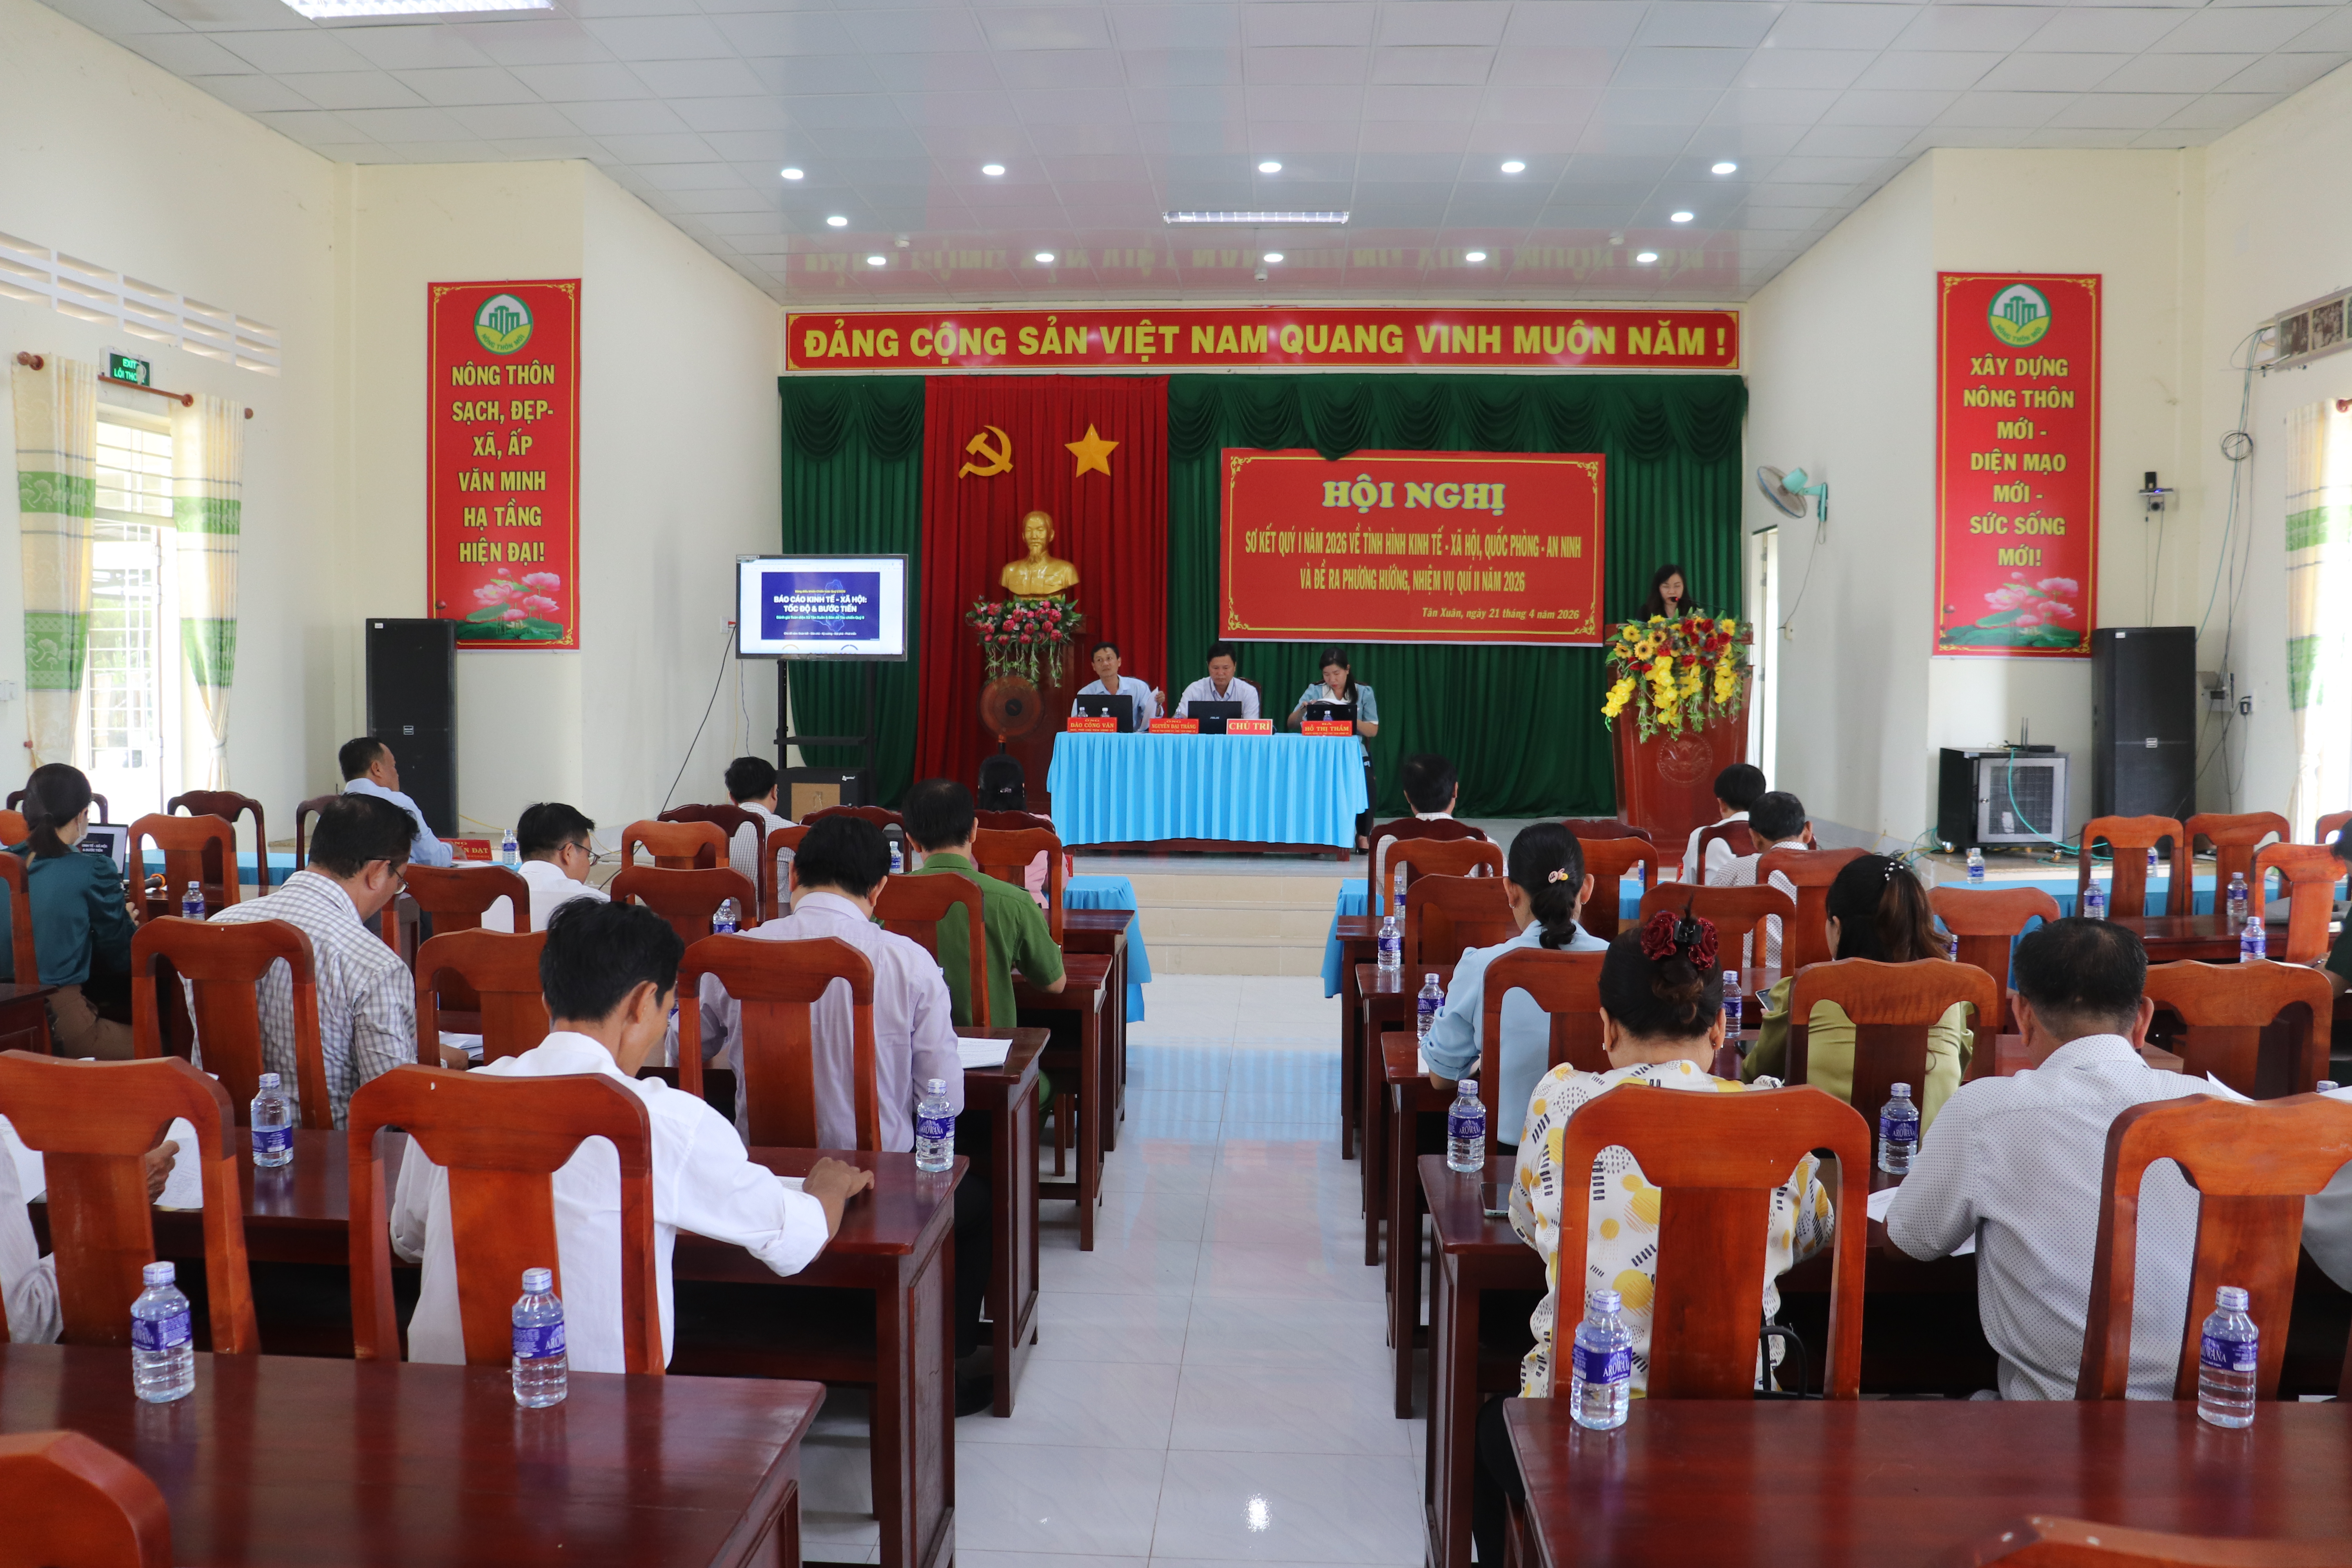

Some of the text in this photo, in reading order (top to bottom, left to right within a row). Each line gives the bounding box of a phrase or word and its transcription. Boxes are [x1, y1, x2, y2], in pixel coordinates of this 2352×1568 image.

[482, 334, 495, 348] NÔNG
[804, 316, 1726, 365] ĐẢNG CỘNG SẢN VIỆT NAM QUANG VINH MUÔN NĂM !
[122, 358, 137, 369] EXIT
[452, 359, 555, 387] NÔNG THÔN
[1970, 352, 2069, 381] XÂY DỰNG
[1963, 385, 2075, 409] NÔNG THÔN
[452, 400, 554, 425] SẠCH, ĐẸP-
[1997, 417, 2035, 440] MỚI
[472, 427, 534, 460] XÃ, ẤP
[1970, 448, 2067, 476] DIỆN MẠO
[458, 468, 546, 492] VĂN MINH
[1993, 480, 2031, 503] MỚI
[1323, 474, 1506, 516] HỘI NGHỊ
[463, 498, 542, 532] HẠ TẦNG
[1969, 510, 2067, 536] SỨC SỐNG
[459, 537, 545, 567] HIỆN ĐẠI!
[1245, 528, 1258, 553] SƠ
[1259, 523, 1276, 553] KẾT
[1278, 526, 1296, 557] QUÝ
[1298, 532, 1302, 553] I
[1304, 528, 1323, 554] NĂM
[1325, 532, 1347, 554] 2026
[1349, 523, 1361, 554] VỀ
[1363, 527, 1383, 554] TÌNH
[1385, 528, 1406, 555] HÌNH
[1408, 533, 1429, 555] KINH
[1431, 526, 1444, 555] TẾ
[1450, 528, 1462, 556] XÃ
[1465, 528, 1482, 561] HỘI,
[1485, 526, 1508, 561] QUỐC
[1510, 529, 1539, 557] PHÒNG
[1546, 536, 1558, 557] AN
[1561, 536, 1582, 558] NINH
[1998, 544, 2043, 567] MỚI!
[1300, 559, 1525, 595] VÀ ĐỀ RA PHƯƠNG HƯỚNG, NHIỆM VỤ QUÍ II NĂM 2026
[773, 594, 789, 603] BÁO
[790, 594, 806, 603] CÁO
[826, 594, 835, 603] TẾ
[840, 595, 851, 603] XÃ
[852, 594, 867, 604] HỘI:
[783, 603, 798, 612] TỐC
[799, 605, 810, 613] ĐỘ
[840, 603, 857, 612] TIẾN
[1422, 608, 1580, 620] Tân Xuân, ngày 21 tháng 4 năm 2026
[1229, 721, 1270, 730] CHỦ TRÌ
[1603, 1357, 1630, 1377] AROWAN
